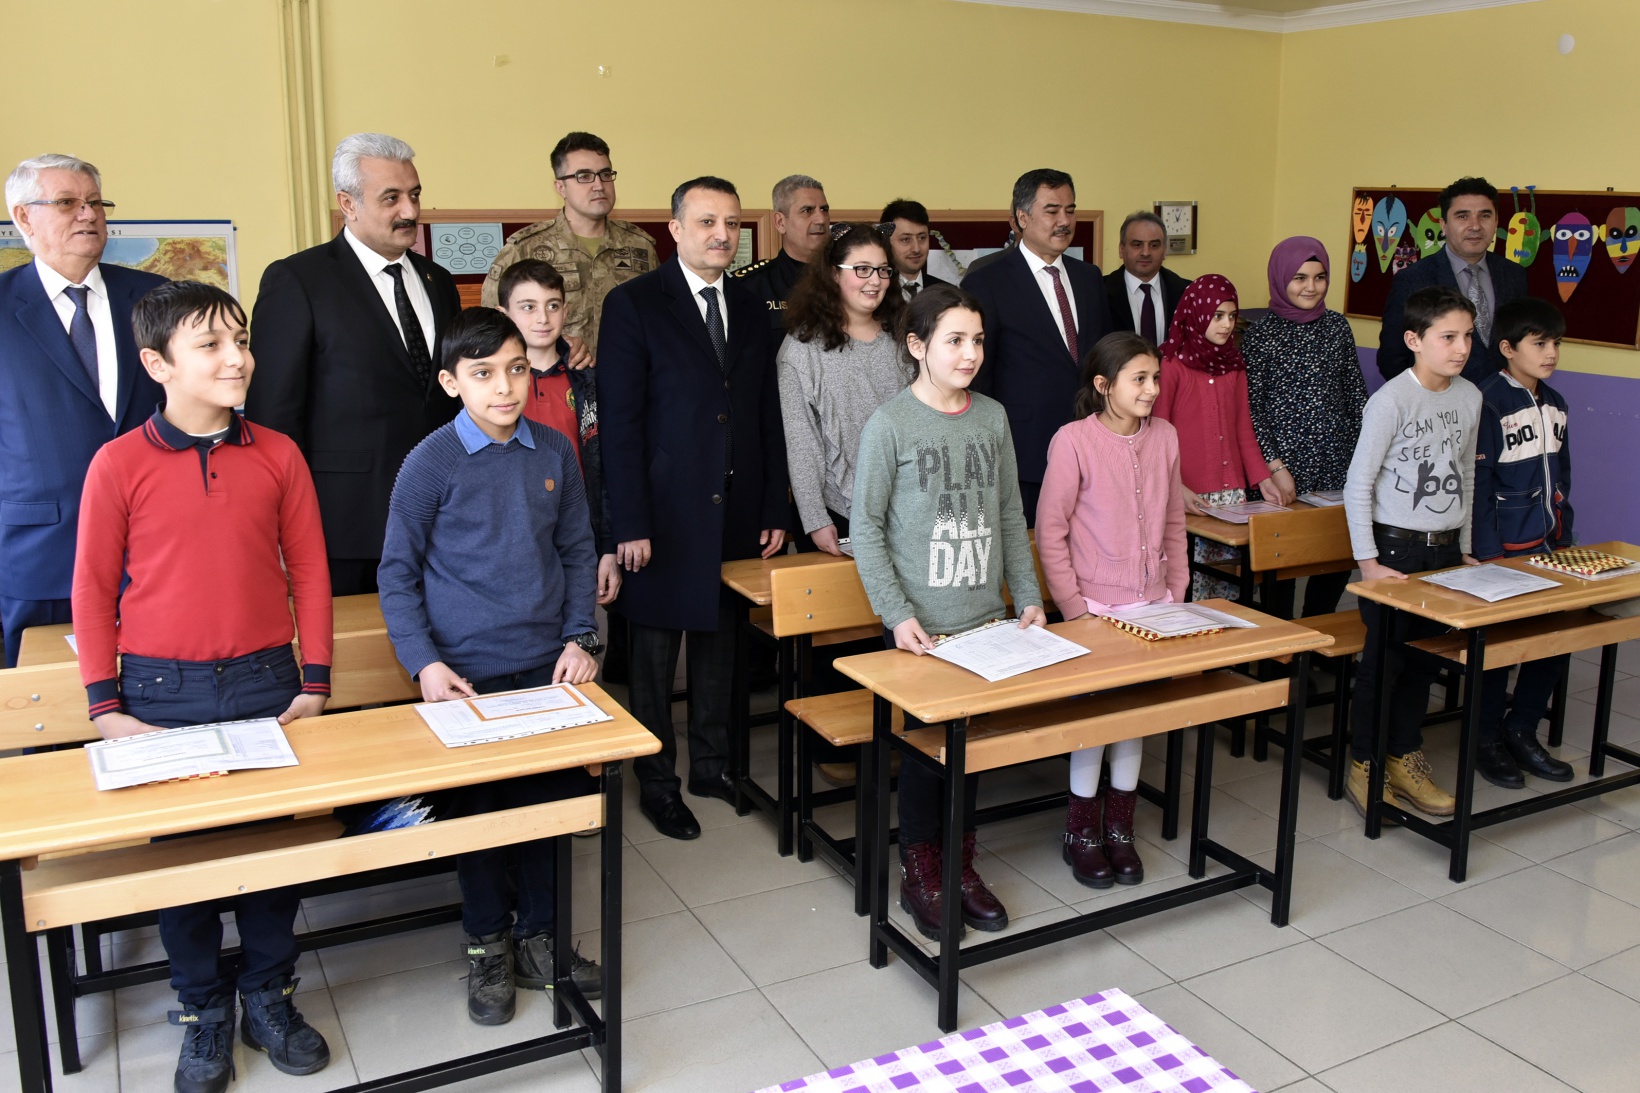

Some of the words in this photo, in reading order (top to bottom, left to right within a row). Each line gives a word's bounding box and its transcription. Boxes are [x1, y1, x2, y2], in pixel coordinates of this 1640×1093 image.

[1397, 445, 1431, 462] SEE
[1441, 429, 1462, 454] M?
[1402, 418, 1434, 438] CAN
[1437, 409, 1458, 429] YOU
[917, 441, 996, 492] PLAY
[932, 491, 992, 540] ALL
[928, 537, 993, 587] DAY
